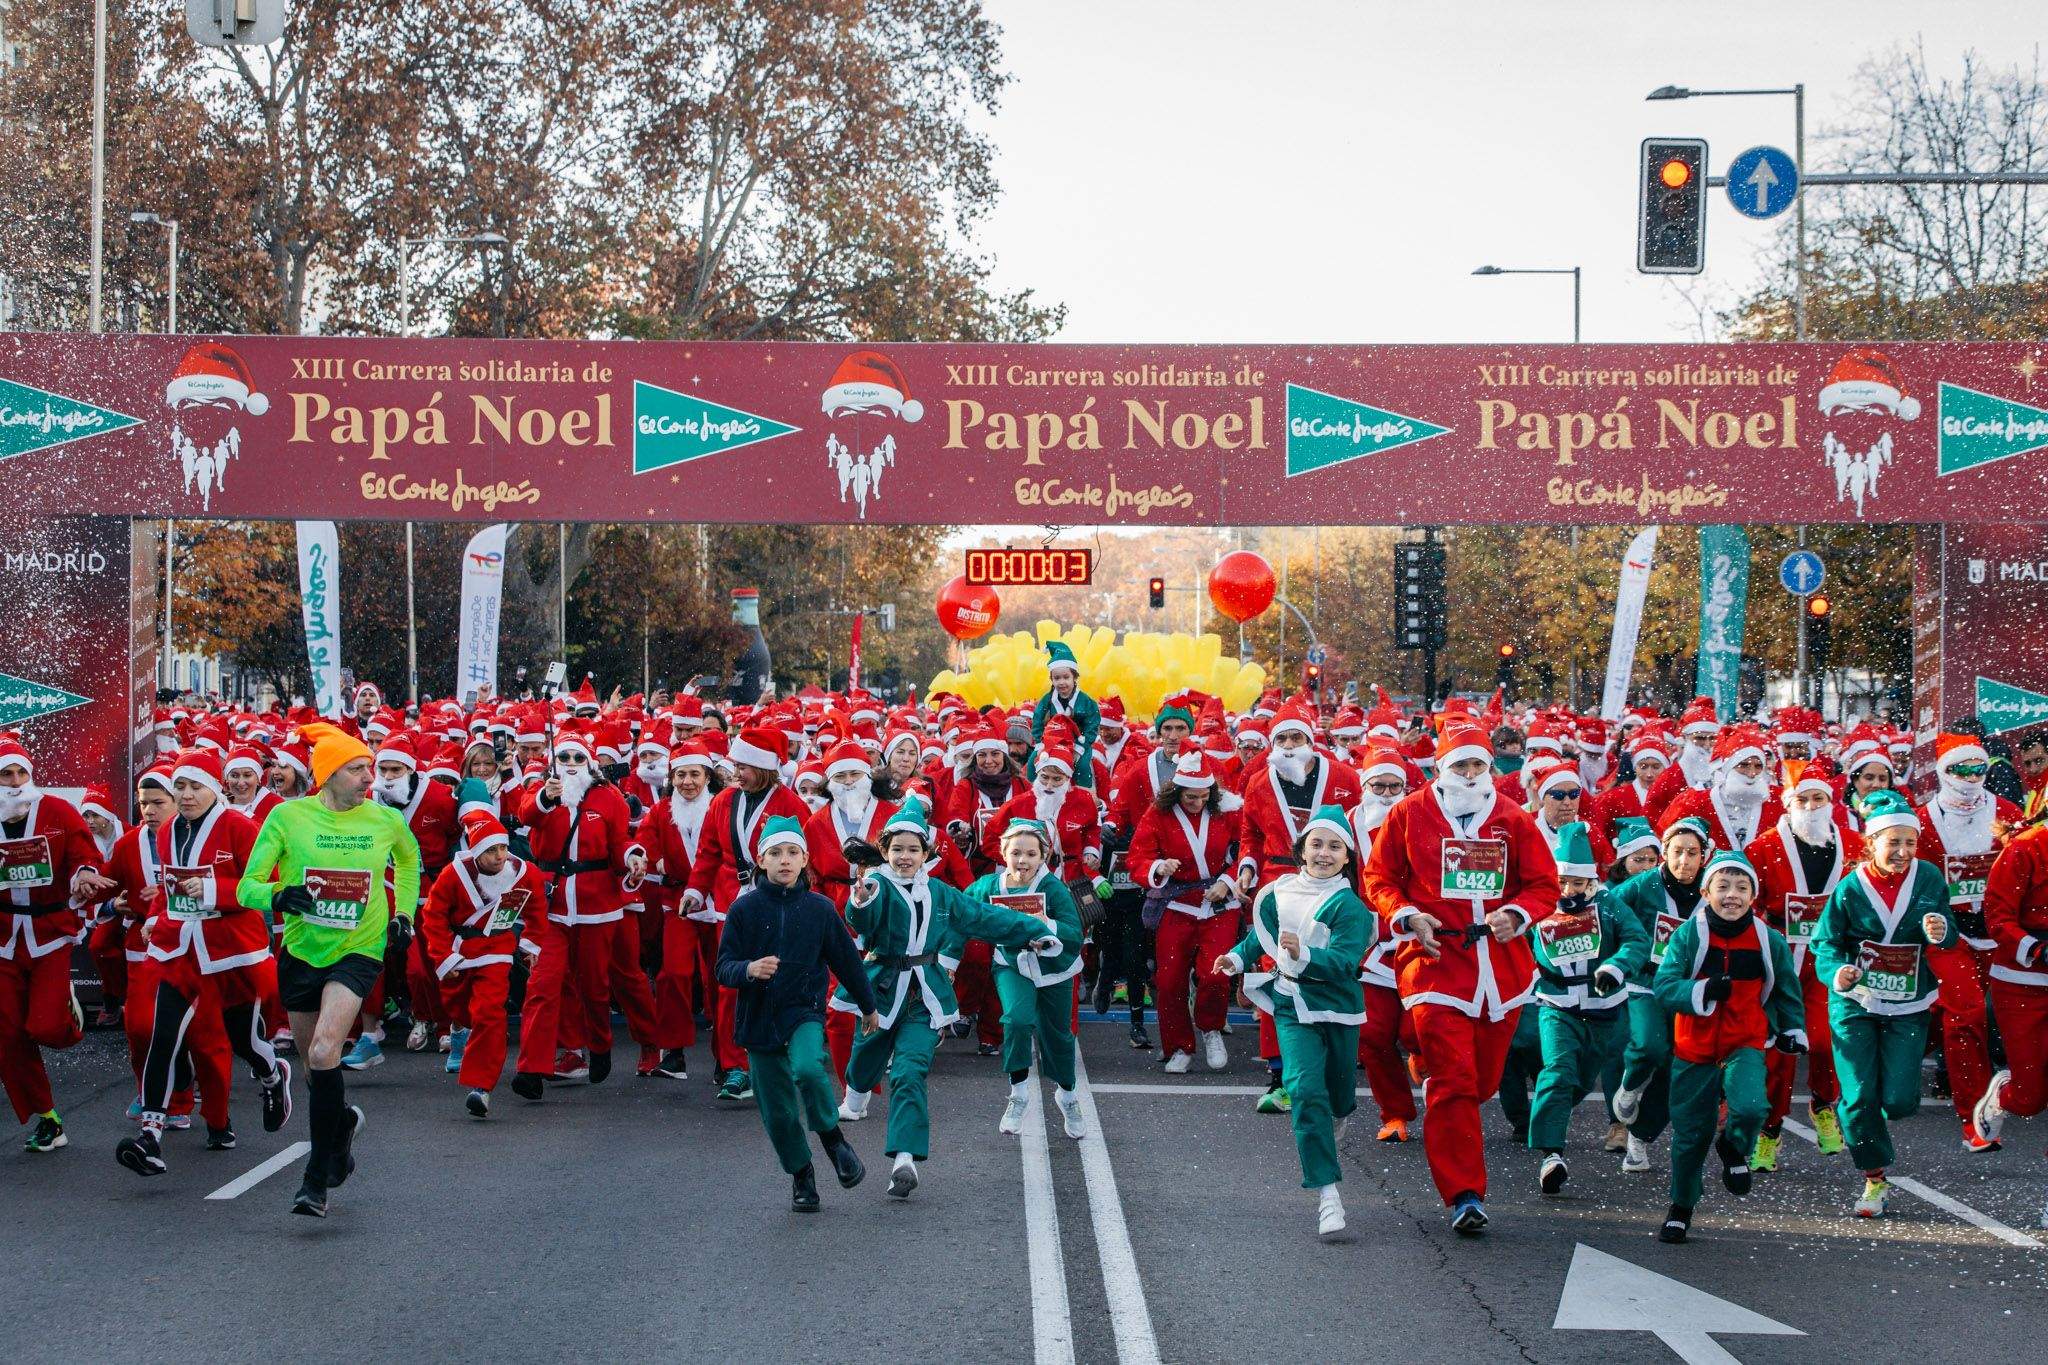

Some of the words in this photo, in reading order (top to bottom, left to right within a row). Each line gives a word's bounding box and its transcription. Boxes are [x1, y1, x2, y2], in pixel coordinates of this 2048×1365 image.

[291, 358, 344, 380] XIII
[352, 359, 453, 382] Carrera
[459, 359, 575, 383] solidaria
[582, 361, 613, 383] de
[946, 364, 999, 386] XIII
[1006, 365, 1106, 387] Carrera
[1112, 364, 1228, 387] solidaria
[1234, 366, 1265, 387] de
[1478, 364, 1531, 387] XIII
[1537, 364, 1638, 387] Carrera
[1644, 364, 1760, 387] solidaria
[1767, 364, 1799, 386] de
[41, 402, 104, 434] Inglés
[288, 391, 450, 460] Papá
[469, 393, 615, 446] Noel
[638, 415, 657, 435] El
[657, 416, 699, 435] Corte
[700, 411, 761, 441] Inglés
[942, 396, 1104, 466] Papá
[1121, 396, 1268, 451] Noel
[1291, 417, 1310, 437] El
[1310, 418, 1351, 437] Corte
[1353, 413, 1413, 443] Inglés
[1474, 396, 1636, 467] Papá
[1654, 395, 1800, 451] Noel
[1943, 416, 1962, 436] El
[1962, 416, 2004, 436] Corte
[360, 471, 387, 500] El
[388, 473, 449, 502] Corte
[451, 468, 541, 512] Inglés
[1014, 477, 1042, 506] El
[1042, 479, 1103, 507] Corte
[1105, 473, 1194, 517] Inglés
[1546, 477, 1575, 506] El
[1575, 478, 1636, 507] Corte
[1637, 472, 1728, 517] Inglés
[5, 551, 106, 572] MADRID
[969, 552, 1086, 582] 00:00:03
[9, 865, 36, 880] 800
[1456, 871, 1496, 889] 6424
[316, 900, 357, 919] 8444
[1555, 935, 1594, 956] 2888
[1866, 970, 1907, 991] 5303
